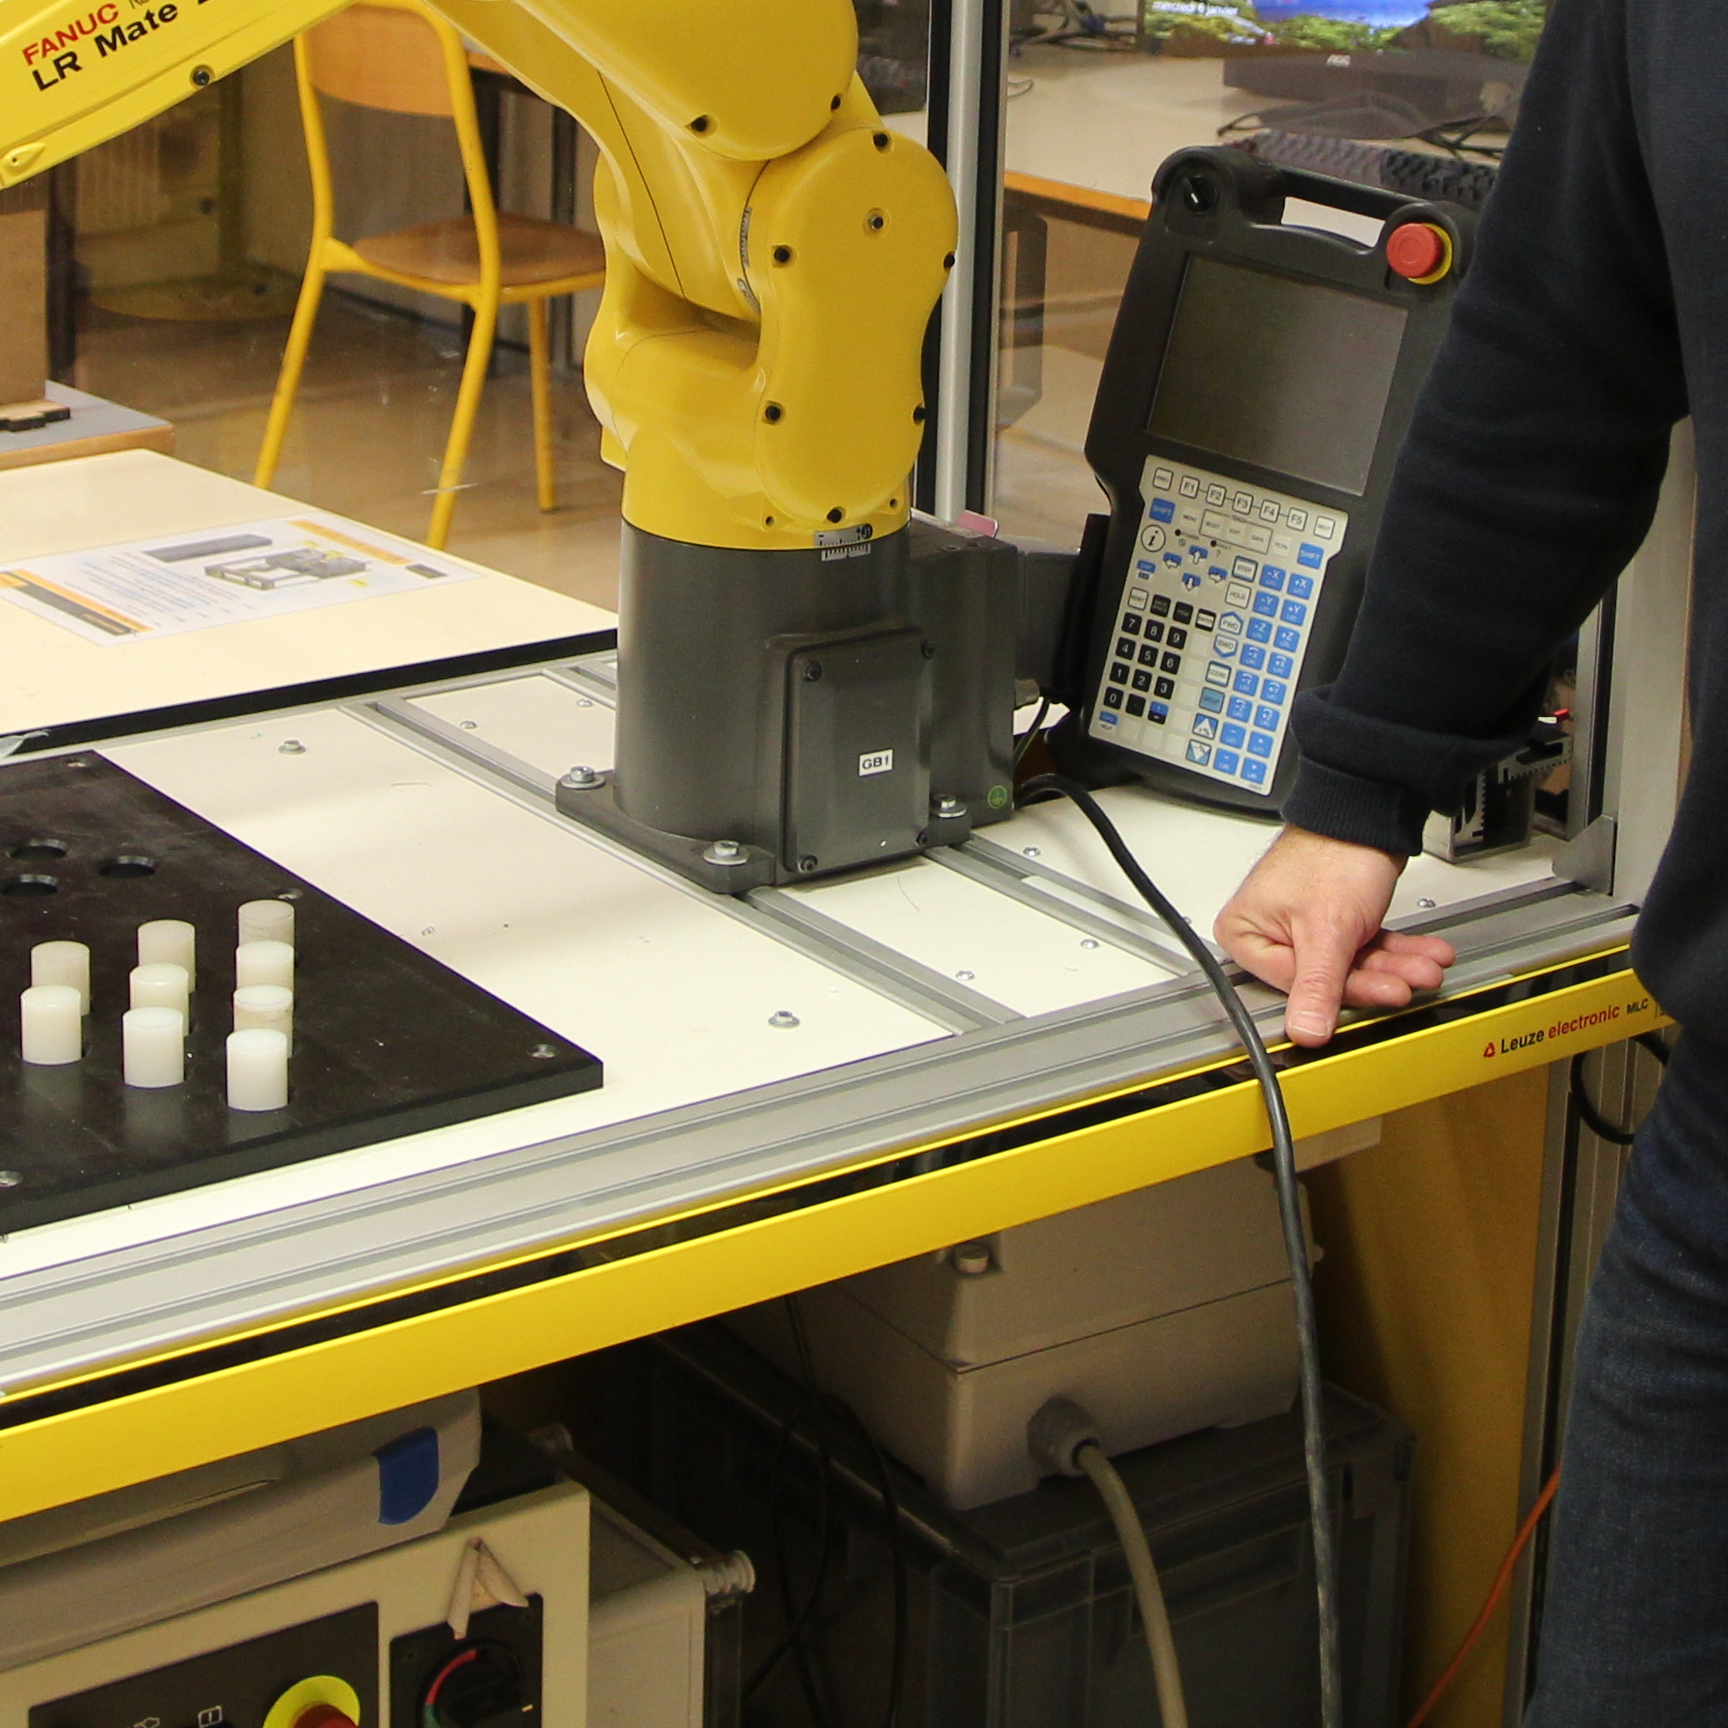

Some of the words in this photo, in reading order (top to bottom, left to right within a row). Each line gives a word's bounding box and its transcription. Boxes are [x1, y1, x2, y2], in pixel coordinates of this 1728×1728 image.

[22, 3, 120, 66] FANUC
[32, 51, 83, 91] LR
[94, 2, 178, 58] Mate
[1184, 482, 1194, 493] F1
[1210, 489, 1222, 501] F2
[1237, 498, 1248, 509] F3
[1264, 505, 1275, 517] F4
[1290, 513, 1302, 525] F5
[862, 754, 890, 771] GB1
[1501, 1028, 1545, 1055] Leuze
[1548, 1003, 1620, 1039] electronic
[1626, 998, 1649, 1016] MLC
